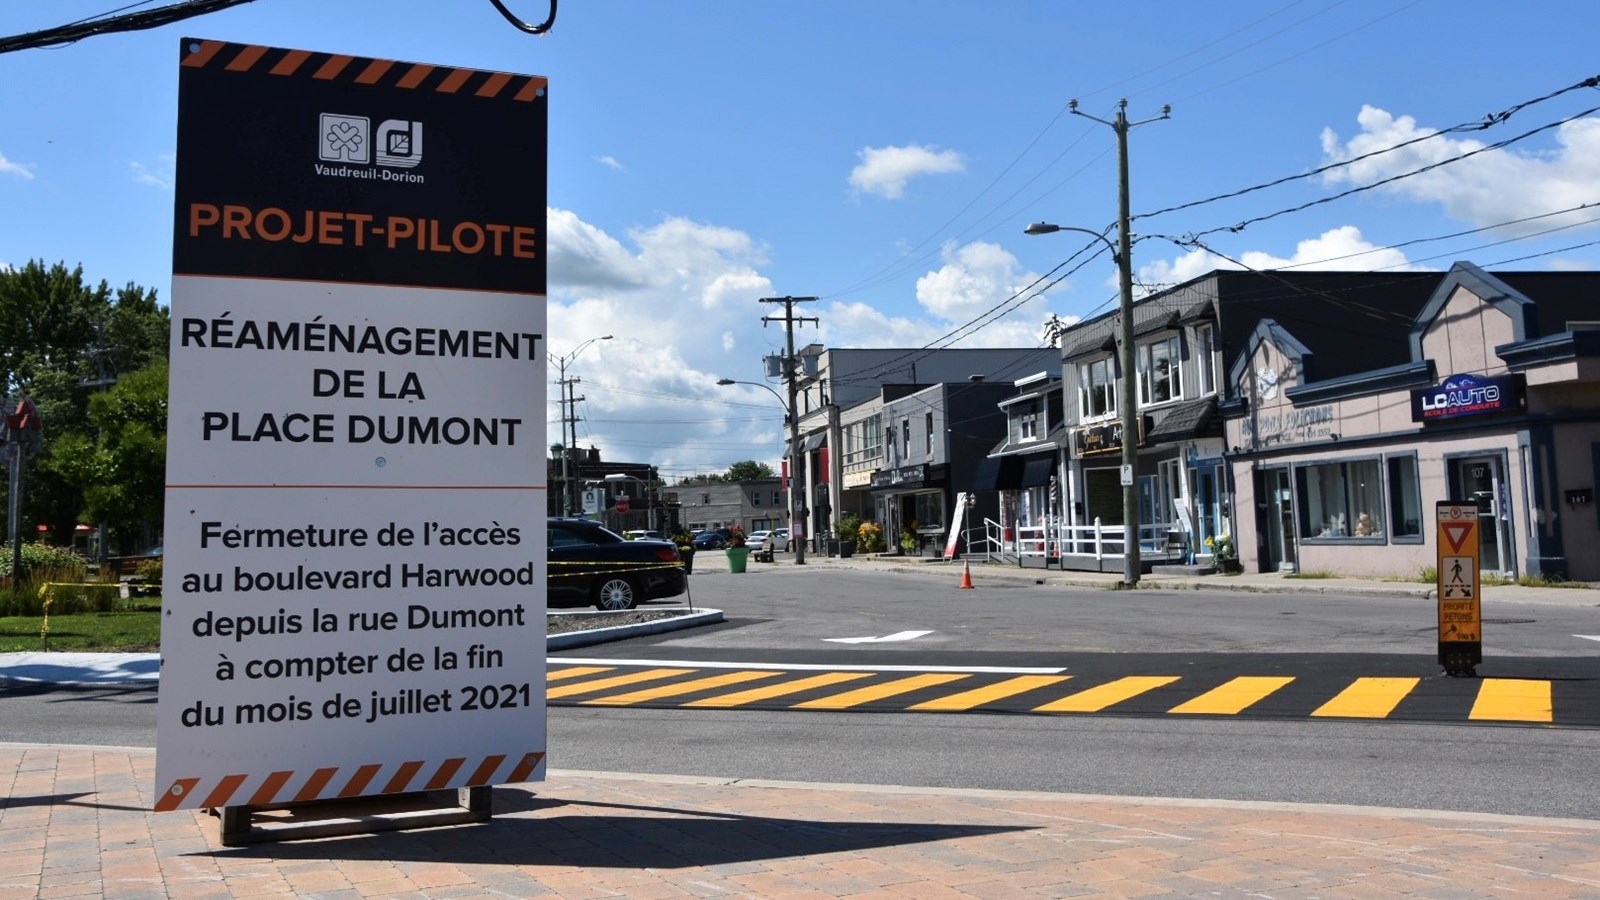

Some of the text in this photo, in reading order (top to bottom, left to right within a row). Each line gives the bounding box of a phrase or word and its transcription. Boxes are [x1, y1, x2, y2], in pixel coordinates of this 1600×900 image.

[314, 163, 425, 184] Vaudreuil-Dorion
[190, 203, 536, 259] PROJET-PILOTE
[181, 311, 542, 361] RÉAMÉNAGEMENT
[313, 369, 425, 400] DE LA
[202, 412, 522, 446] PLACE DUMONT
[1472, 467, 1484, 478] 107
[201, 521, 521, 549] Fermeture de l'accès
[182, 562, 534, 594] au boulevard Harwood
[193, 604, 525, 642] depuis la rue Dumont
[216, 644, 503, 682] à compter de la fin
[182, 683, 530, 727] du mois de juillet 2021
